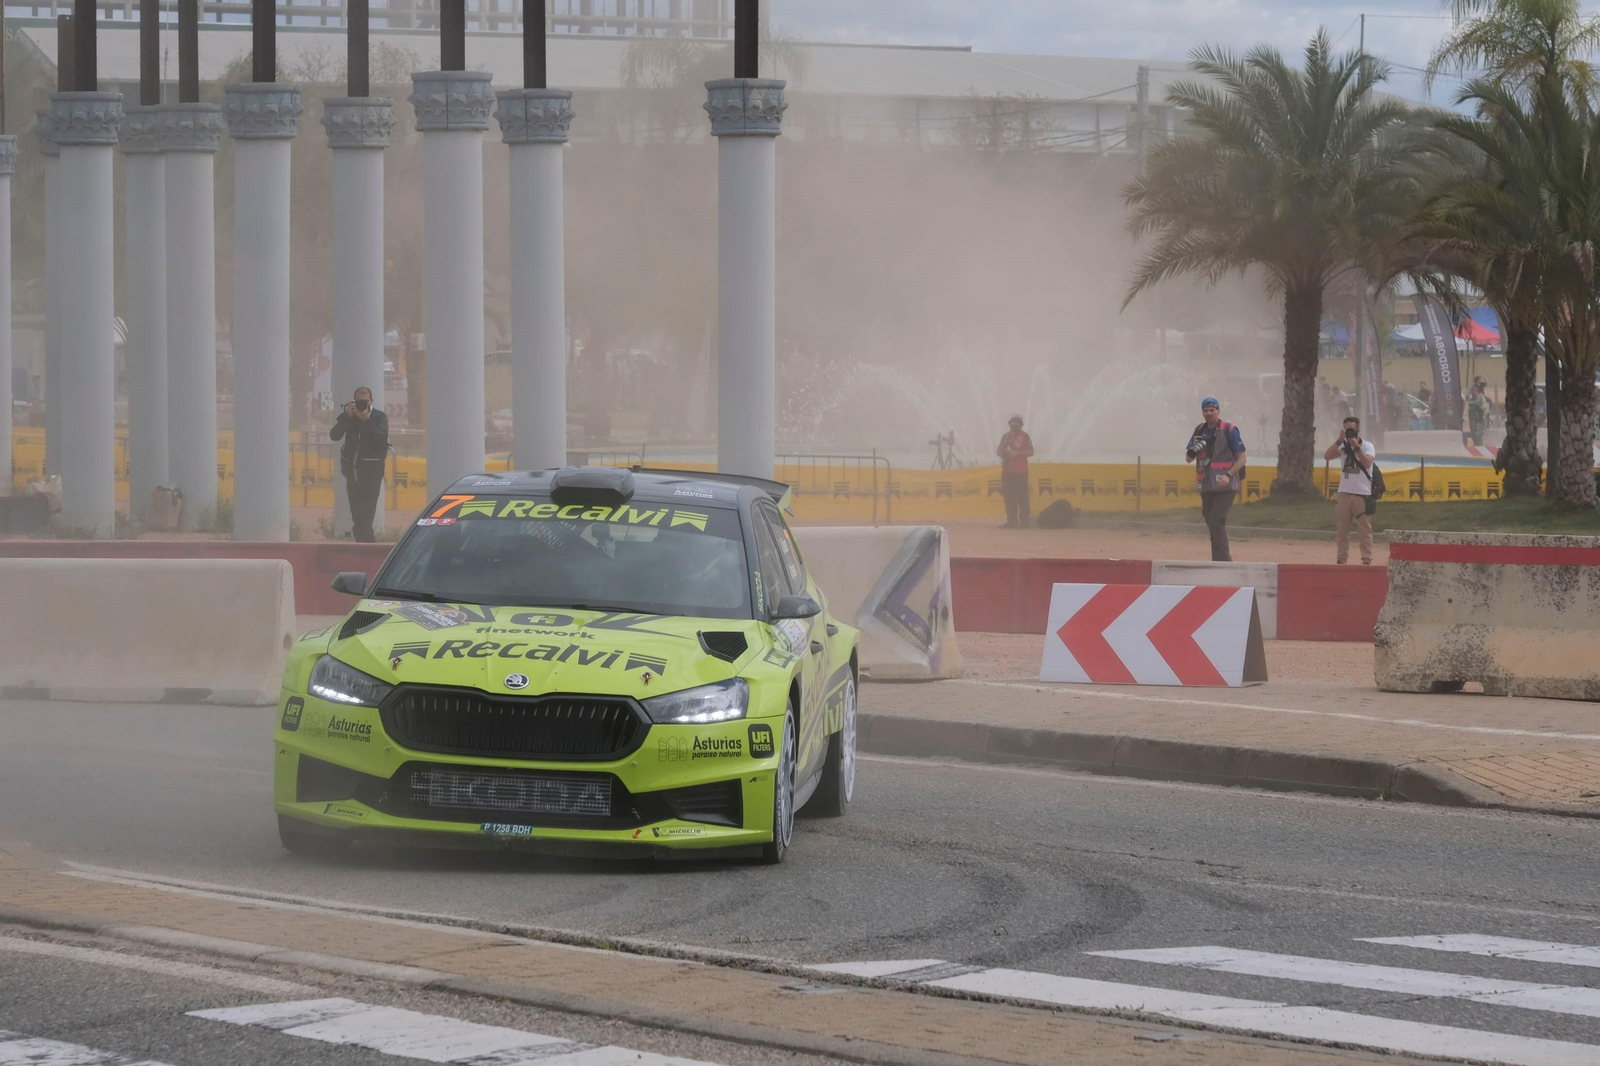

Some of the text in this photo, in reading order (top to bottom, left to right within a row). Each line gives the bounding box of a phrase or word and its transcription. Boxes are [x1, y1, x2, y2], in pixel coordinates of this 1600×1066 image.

[430, 495, 476, 518] 7
[497, 500, 669, 527] Recalvi
[475, 626, 596, 640] finetwork
[432, 639, 626, 669] Recalvi
[286, 703, 301, 717] UFI
[328, 715, 372, 735] Asturias
[350, 734, 371, 743] natural
[692, 735, 742, 751] Asturias
[752, 731, 770, 744] UFI
[719, 749, 742, 758] natural
[753, 744, 771, 752] FILTERS
[512, 824, 531, 834] BDH
